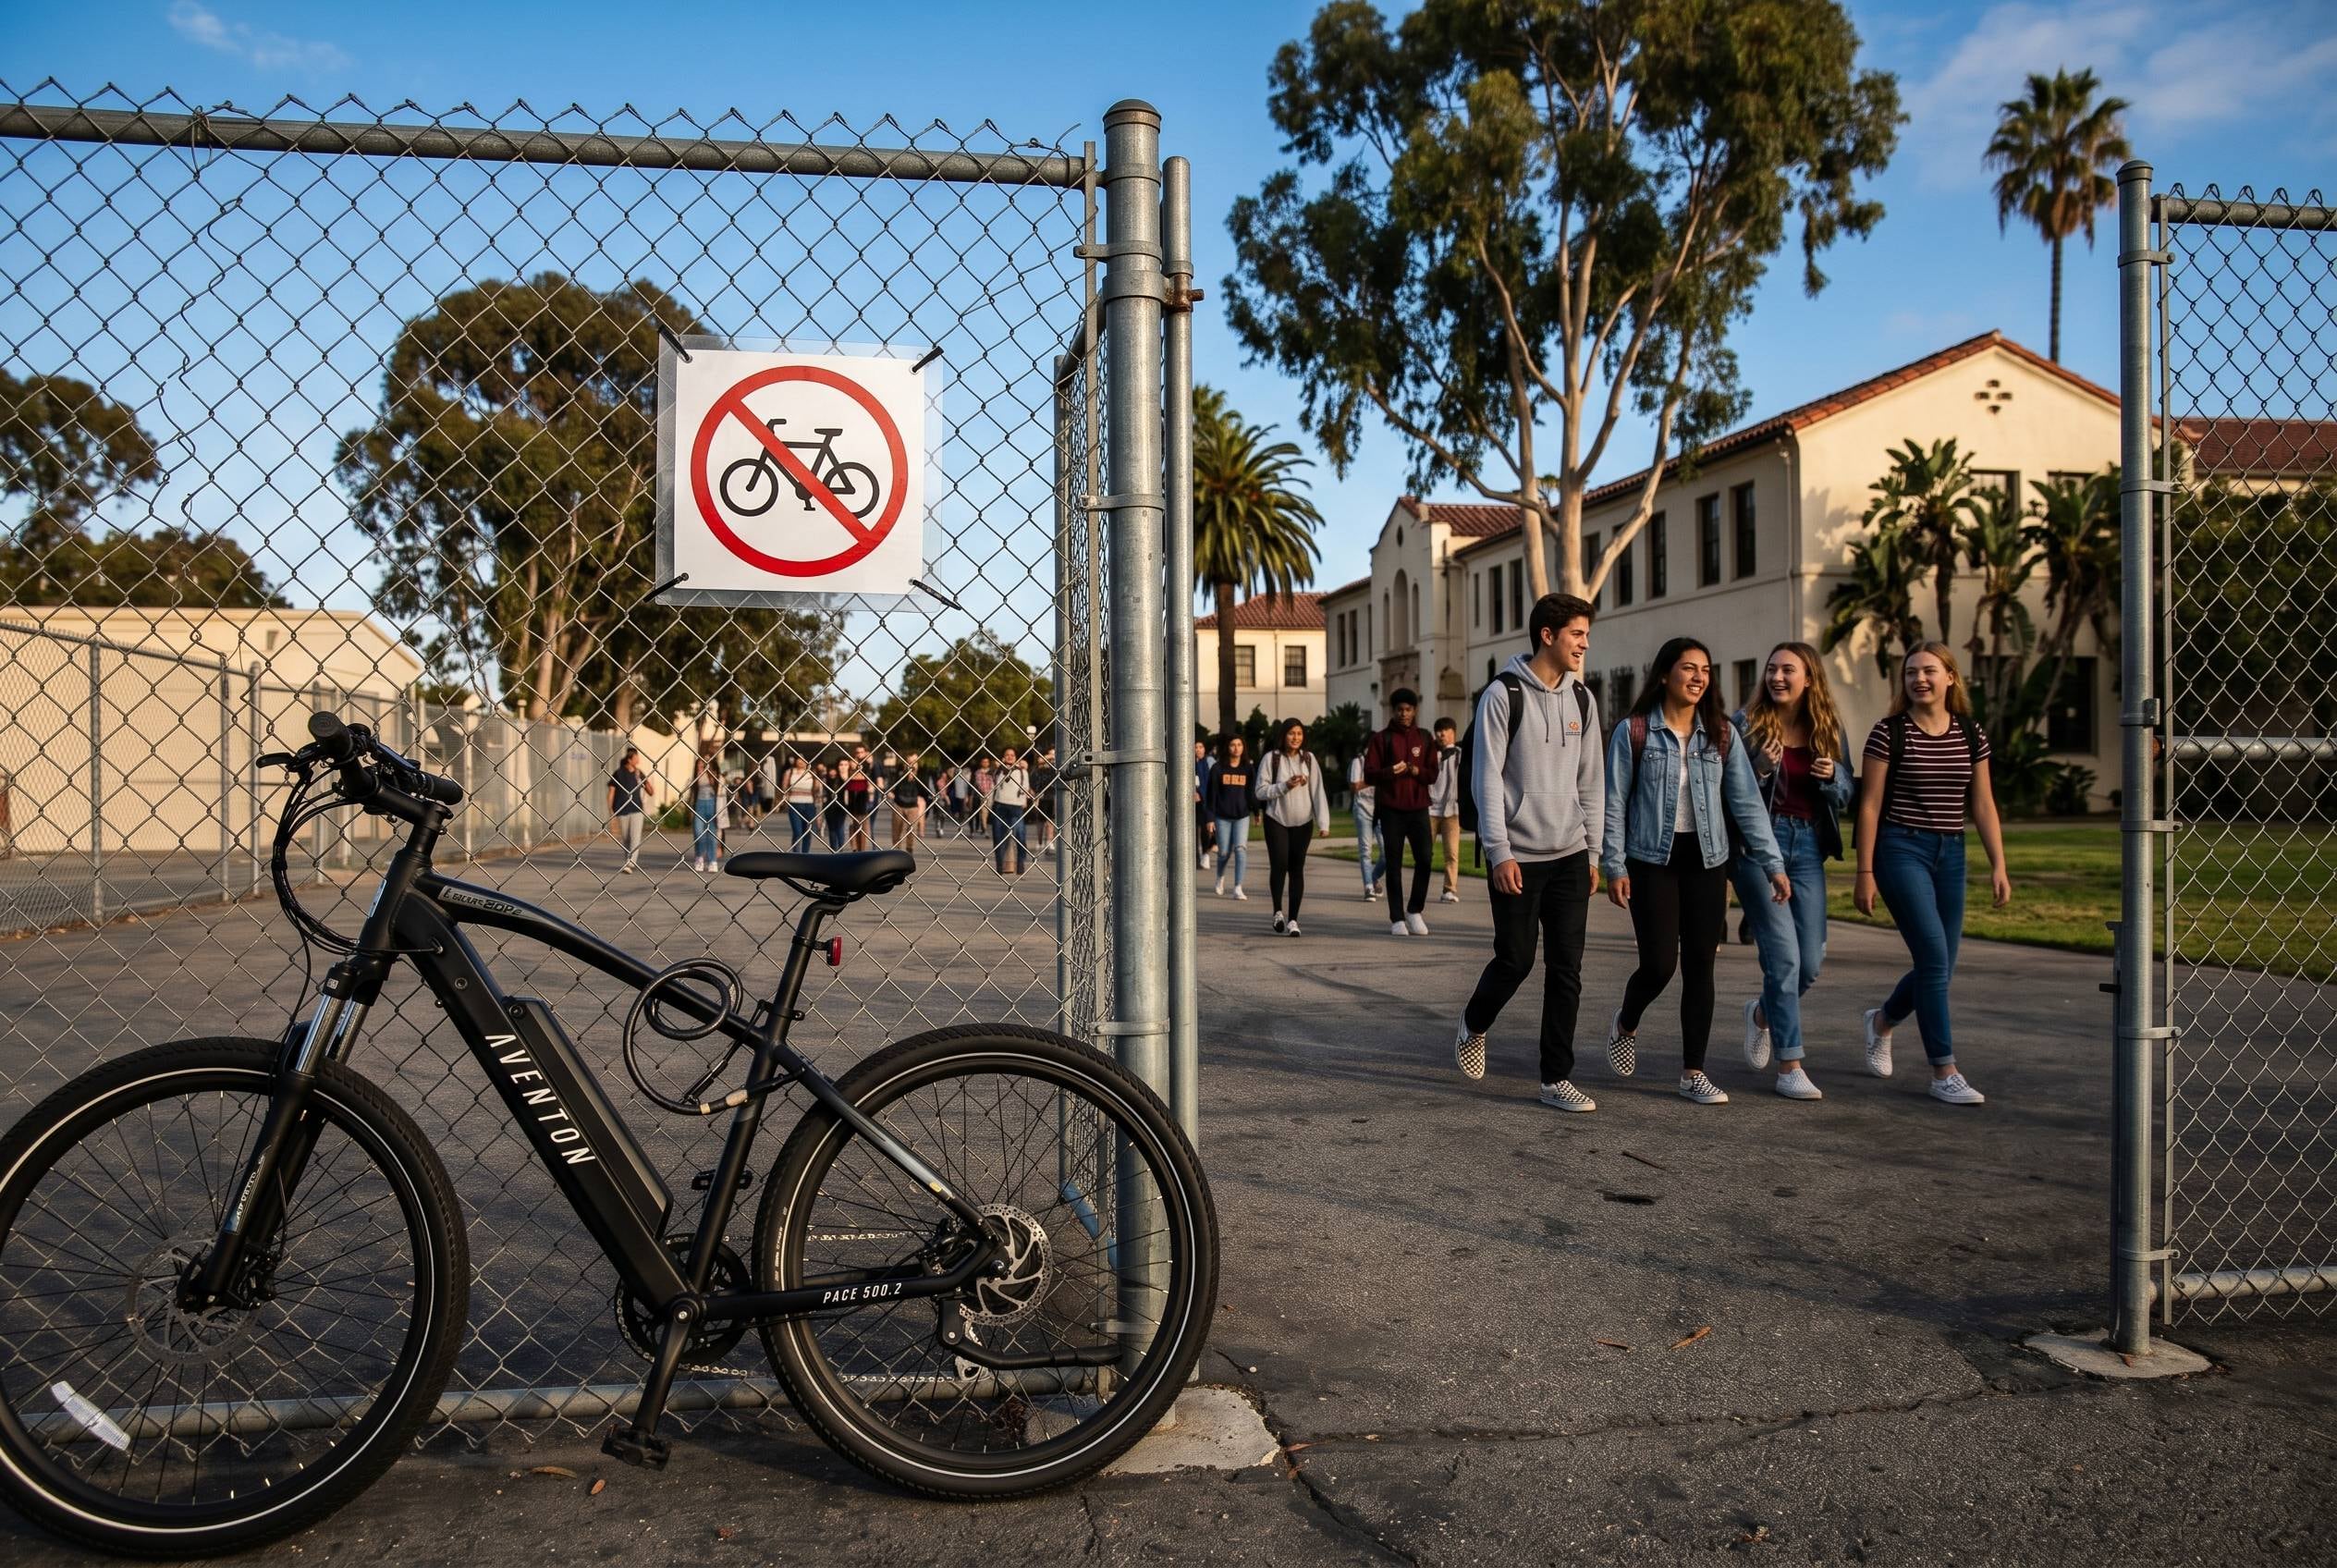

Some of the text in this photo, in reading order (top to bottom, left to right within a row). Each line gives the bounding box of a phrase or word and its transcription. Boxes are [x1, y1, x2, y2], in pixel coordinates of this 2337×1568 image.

[484, 1034, 596, 1165] AVENTON
[823, 1282, 902, 1304] PACE 500.2
